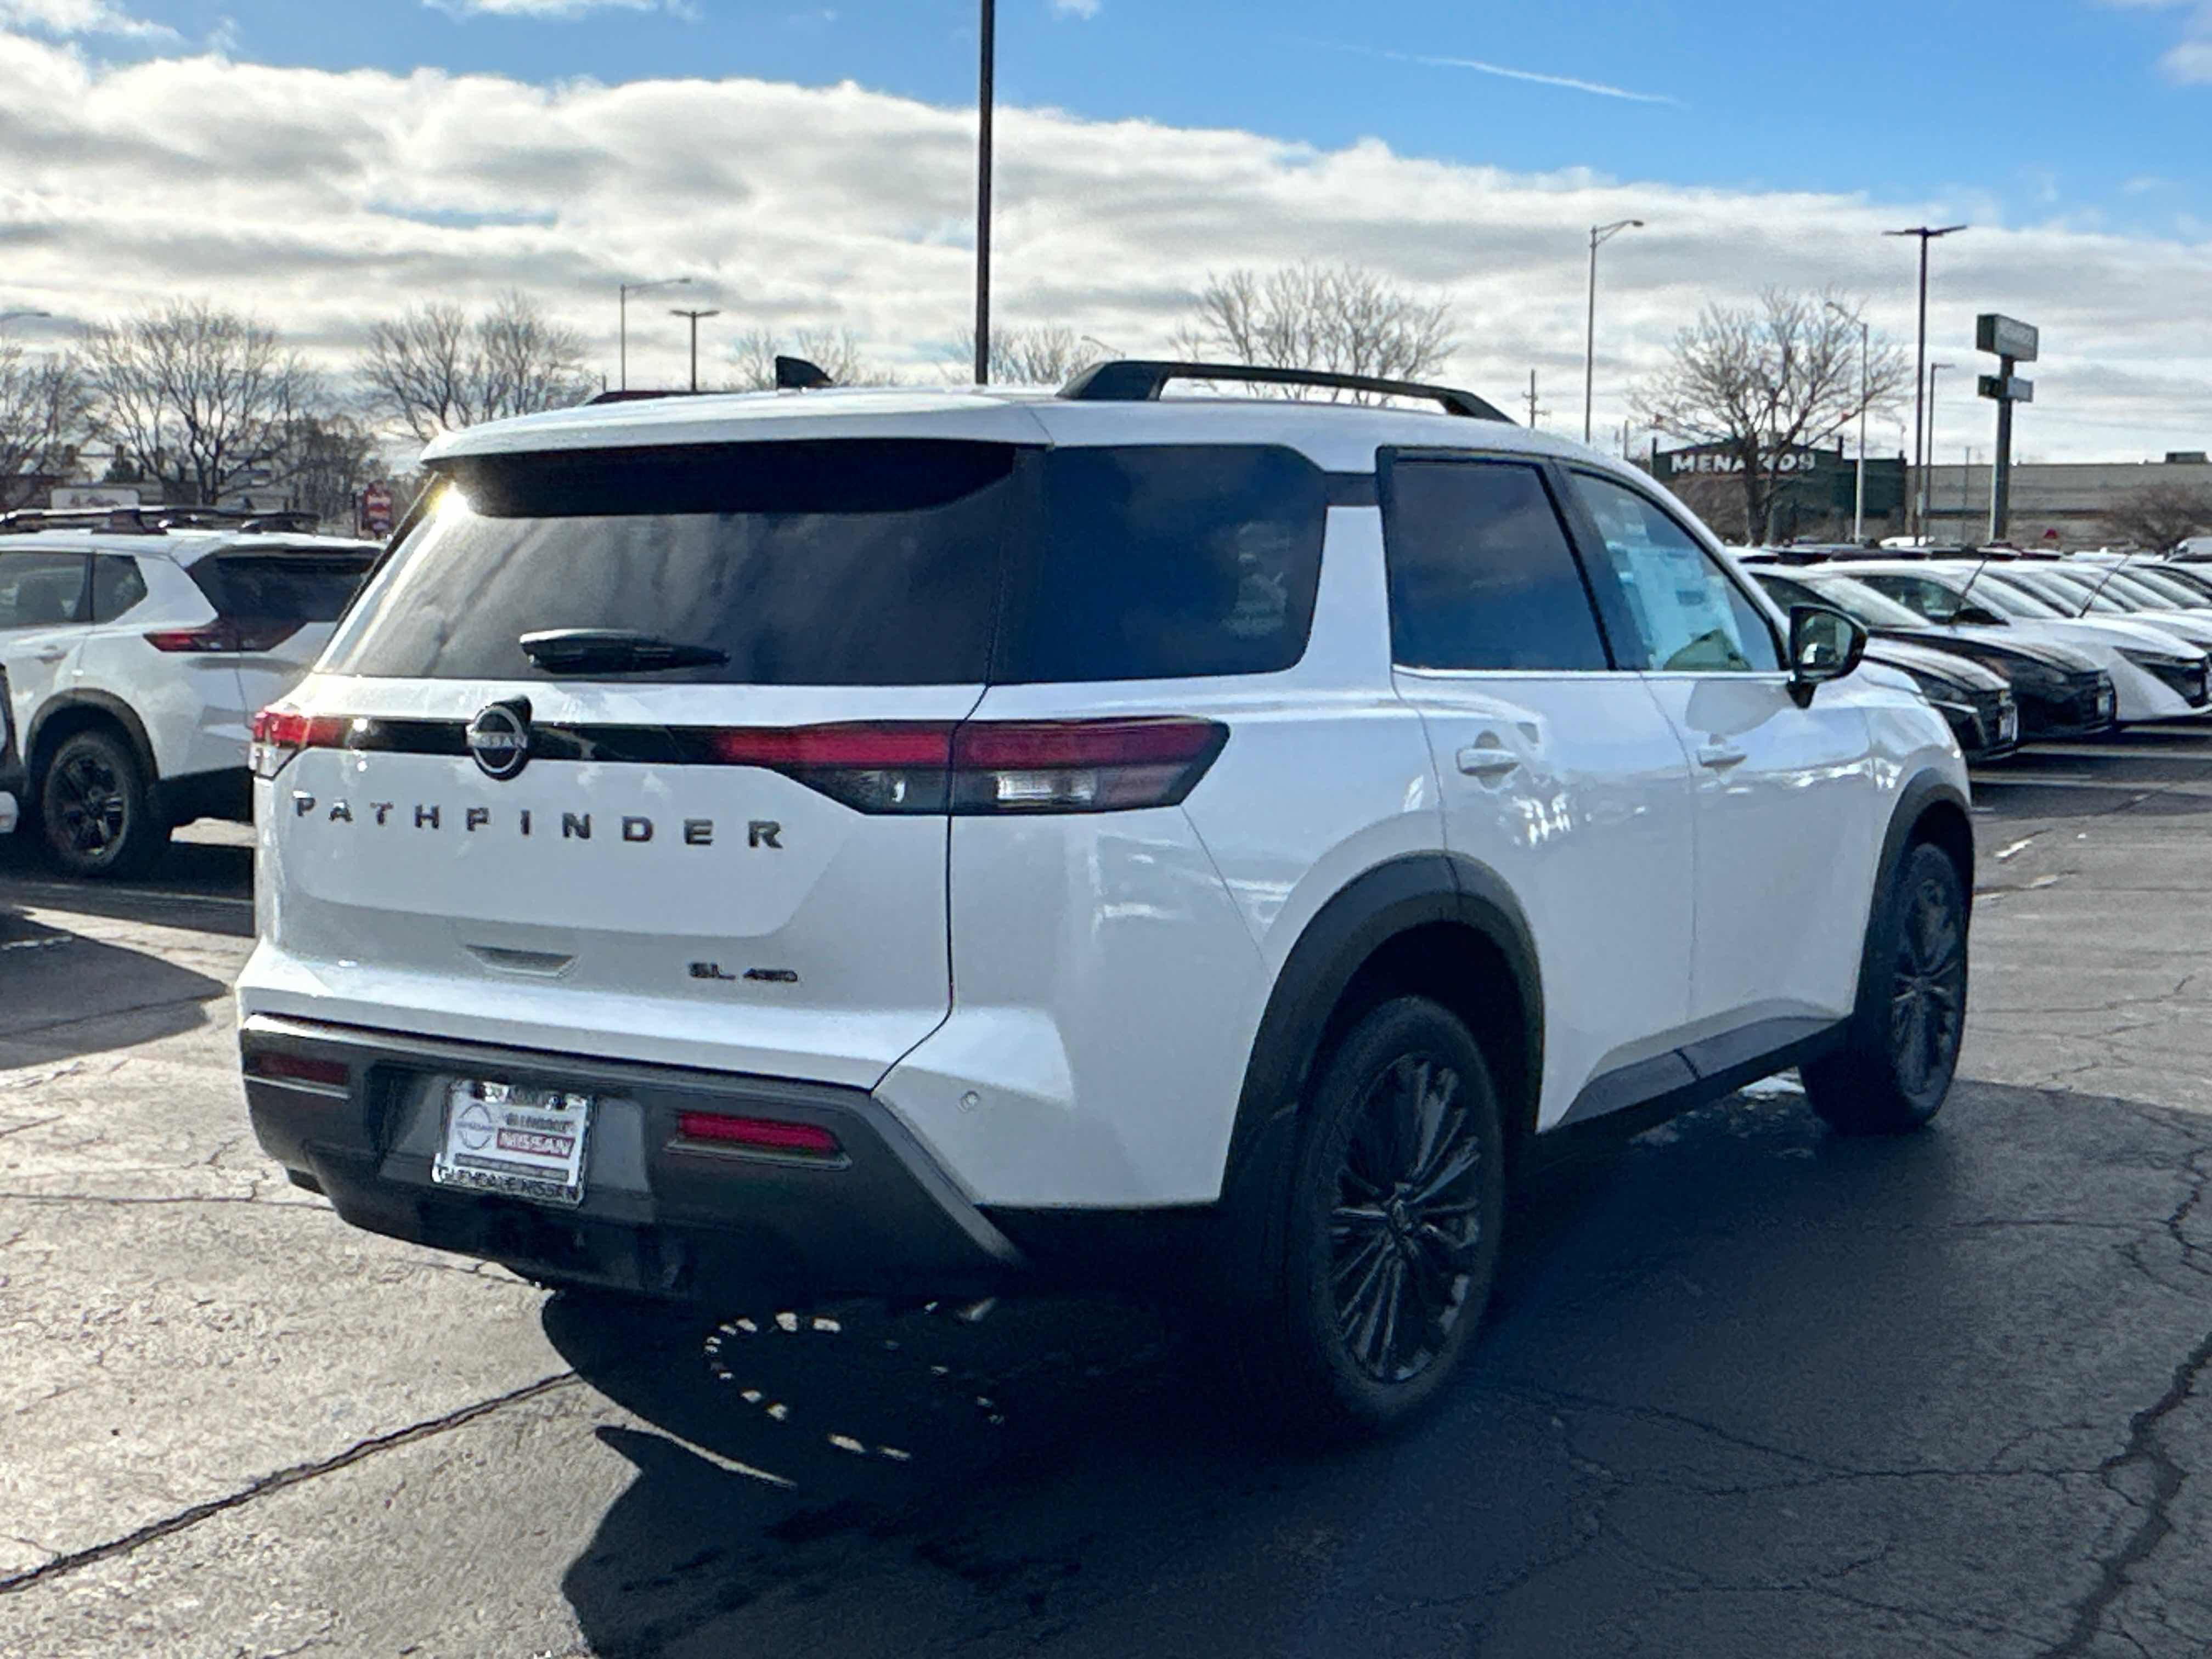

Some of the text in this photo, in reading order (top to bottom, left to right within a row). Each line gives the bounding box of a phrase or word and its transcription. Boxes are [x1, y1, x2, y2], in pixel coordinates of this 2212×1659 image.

[294, 791, 783, 848] PATHFINDER
[690, 962, 736, 980] SL
[501, 1131, 571, 1155] NISSAN
